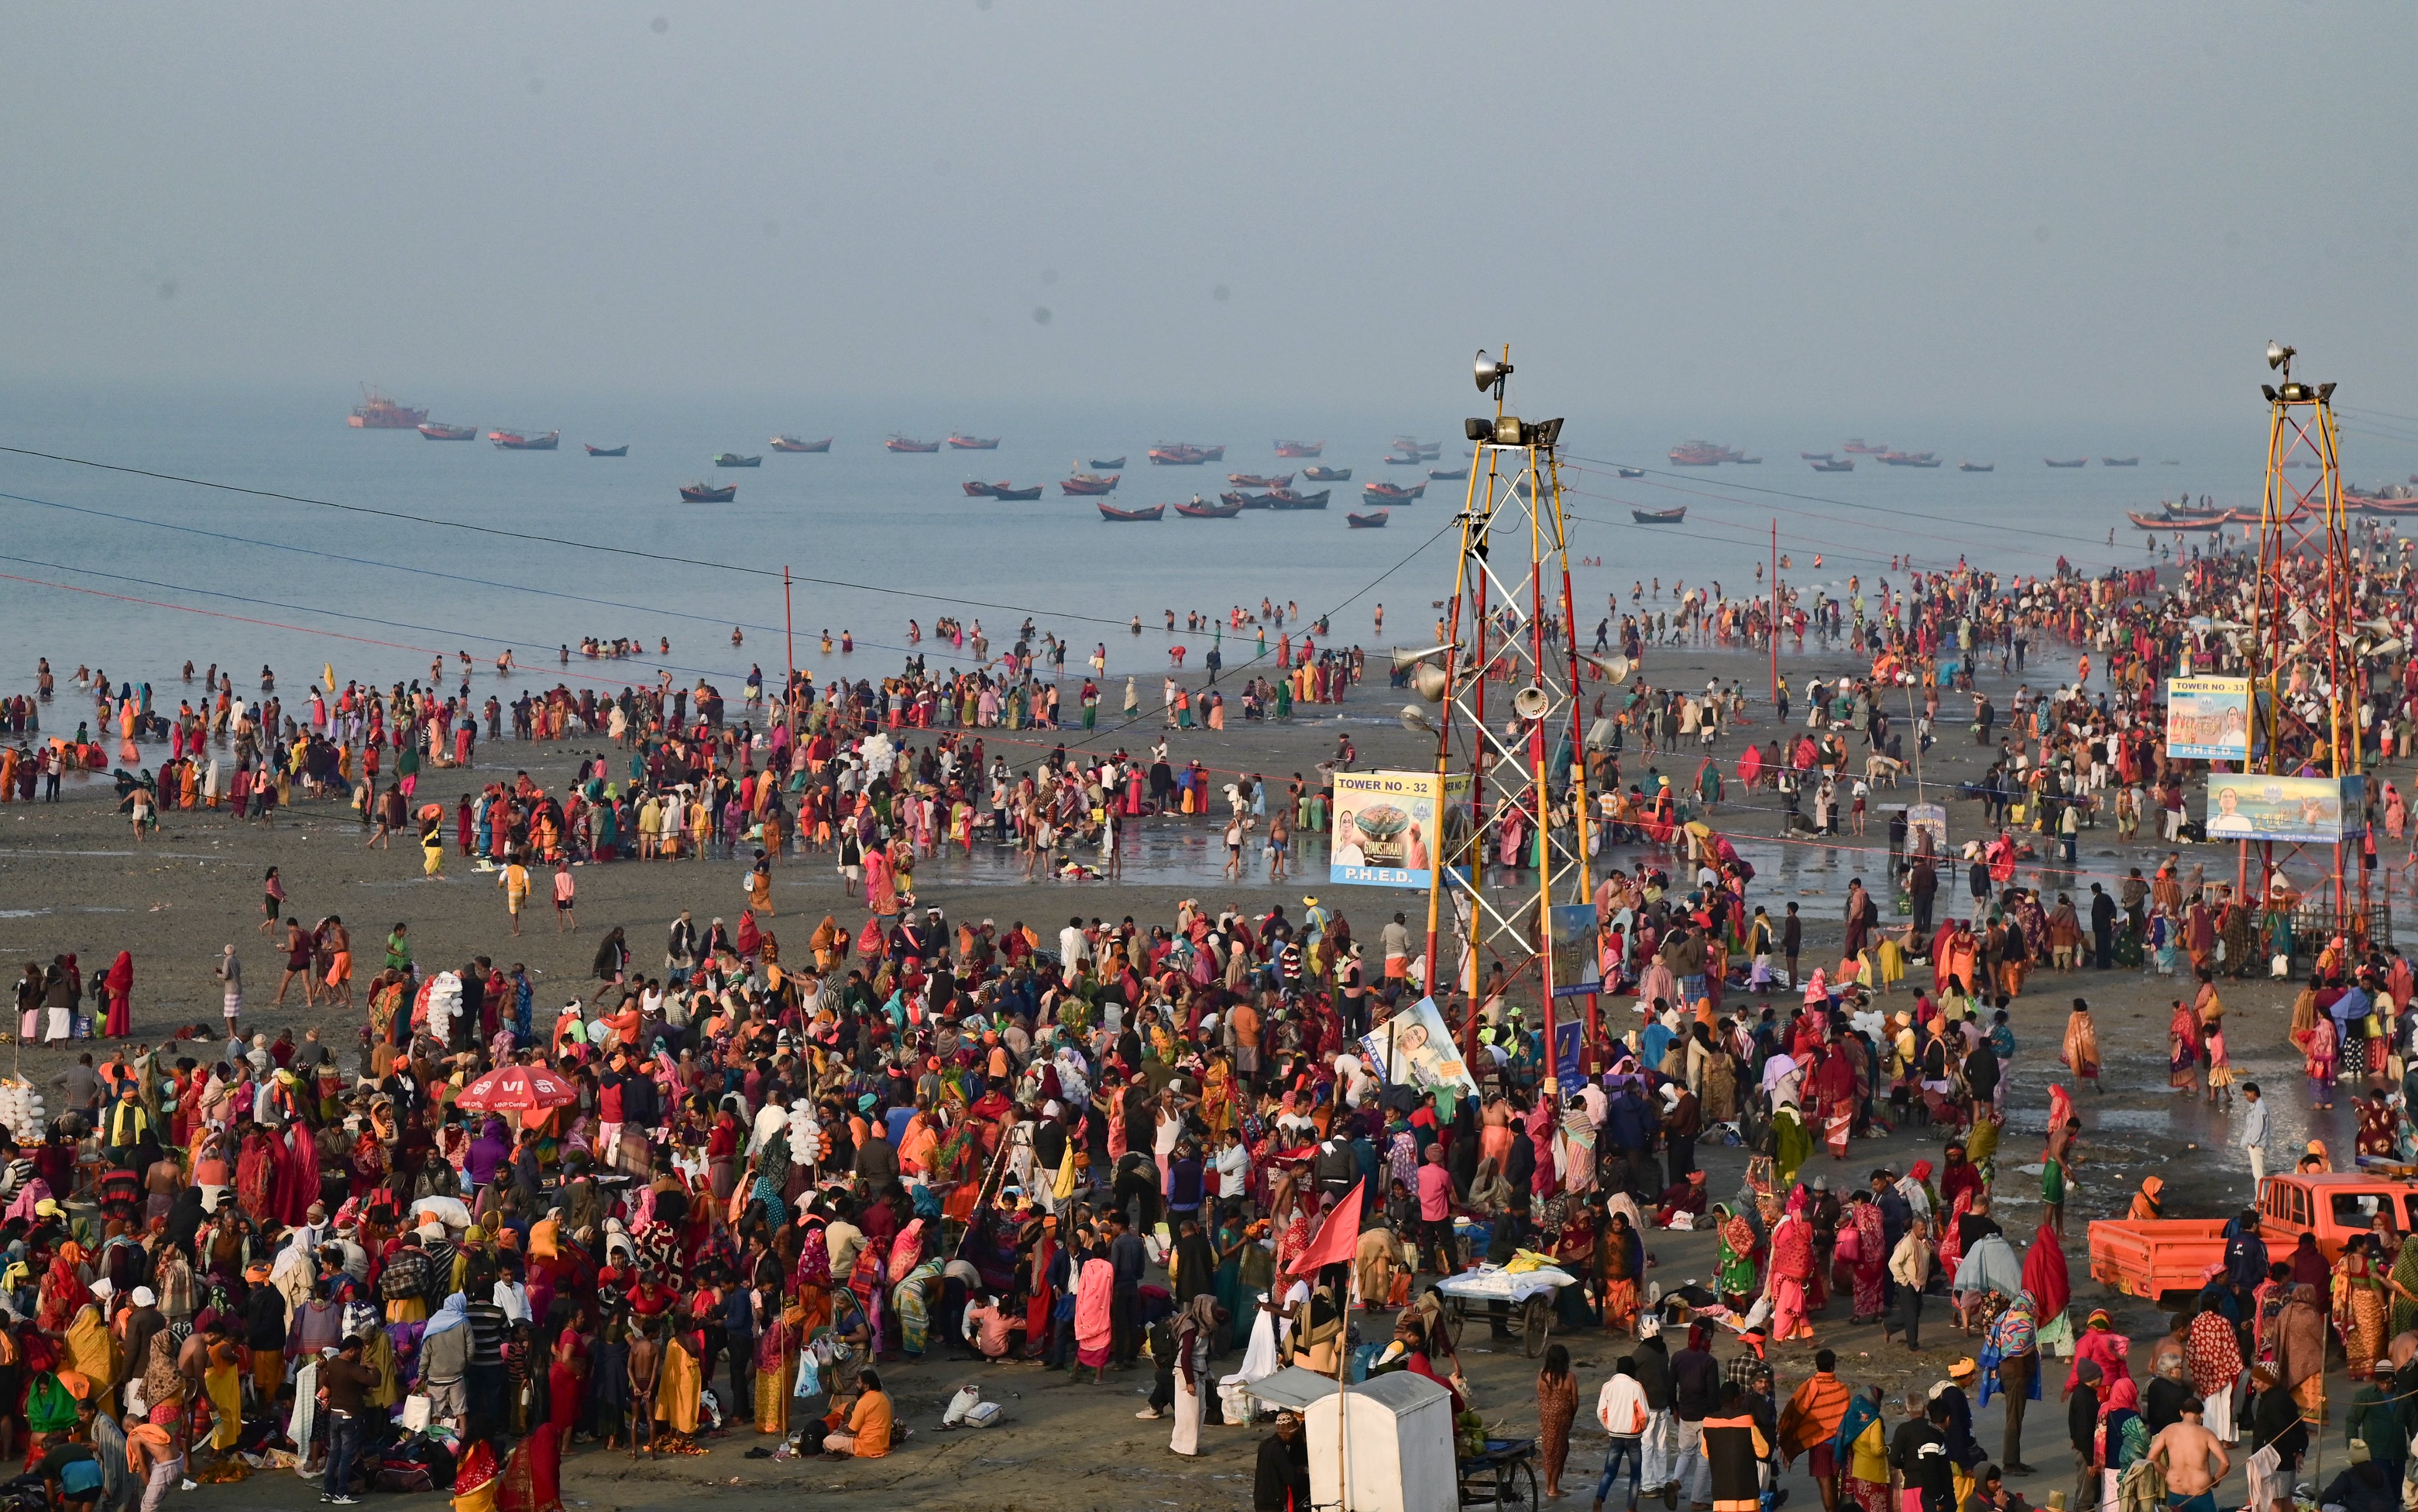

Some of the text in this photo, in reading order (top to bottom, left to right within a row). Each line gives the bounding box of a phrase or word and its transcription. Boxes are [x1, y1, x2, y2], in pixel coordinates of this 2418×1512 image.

[2182, 745, 2235, 756] P.H.E.D.
[1338, 778, 1381, 790] TOWER
[1385, 781, 1403, 791] NO
[1413, 783, 1427, 793] 32
[1364, 840, 1403, 856] GYANSTHAAN
[1345, 868, 1413, 883] P.H.E.D.
[1364, 1039, 1378, 1062] P.H.E.D.
